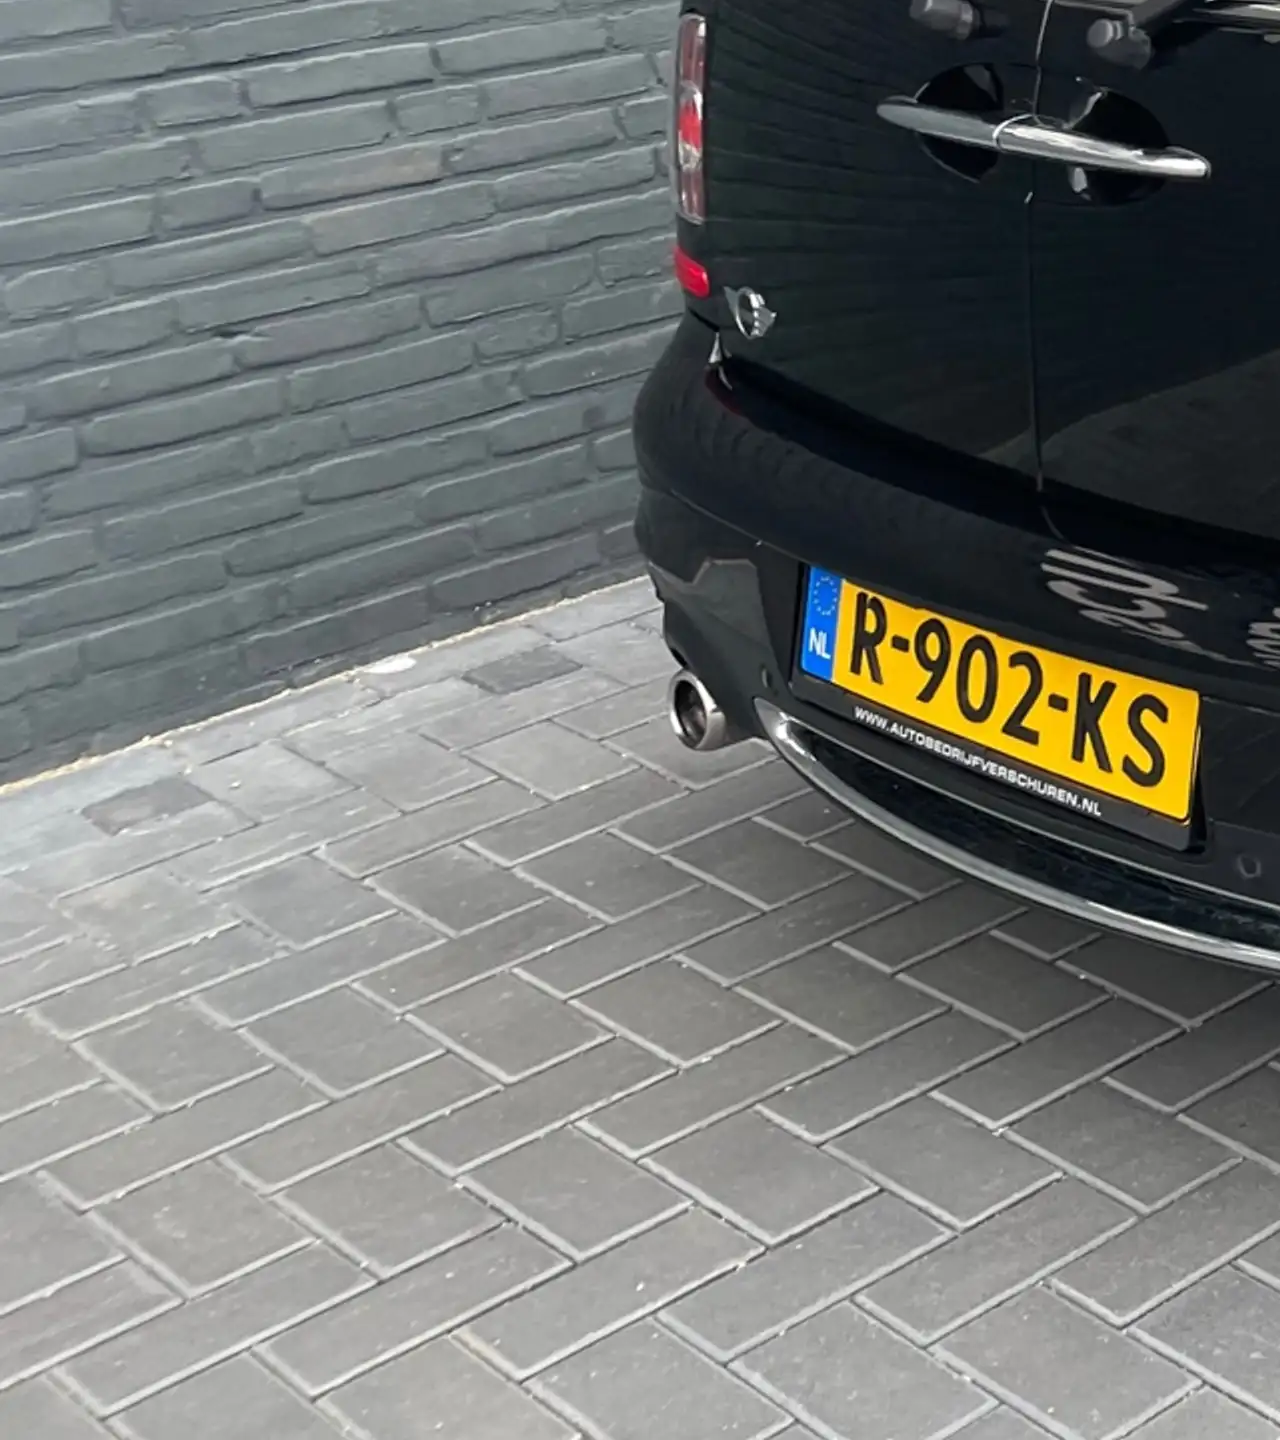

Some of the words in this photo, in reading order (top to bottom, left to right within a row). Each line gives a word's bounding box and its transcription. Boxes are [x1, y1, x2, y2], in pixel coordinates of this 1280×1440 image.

[808, 627, 831, 660] NL
[849, 591, 1170, 788] R-902-KS
[854, 705, 1102, 816] WWW.AUTOBEDRIJFVERSCHUREN.NL
